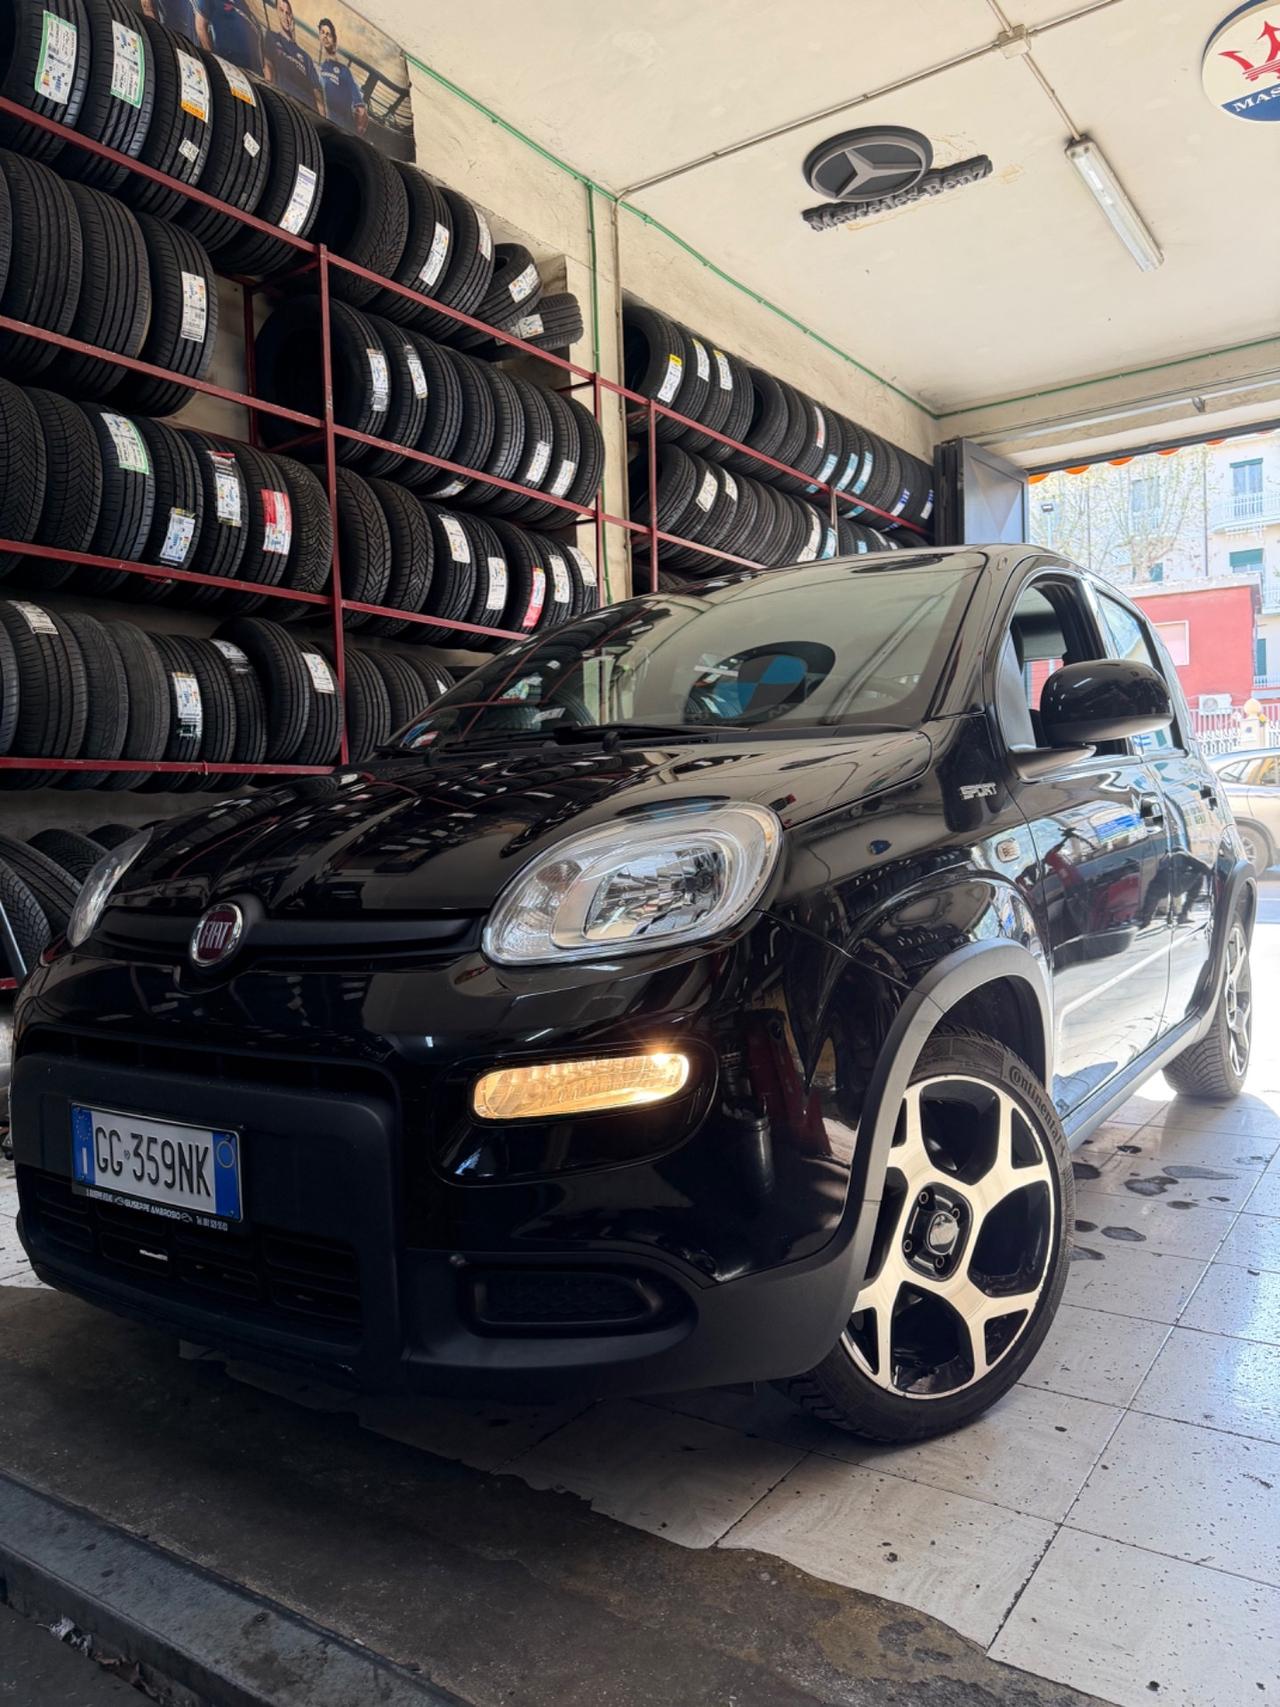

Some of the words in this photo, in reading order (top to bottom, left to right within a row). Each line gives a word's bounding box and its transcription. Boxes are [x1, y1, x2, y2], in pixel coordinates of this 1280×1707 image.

[804, 157, 992, 232] Mercedes-Benz
[199, 921, 232, 949] FIAT
[1009, 1065, 1062, 1145] Continental
